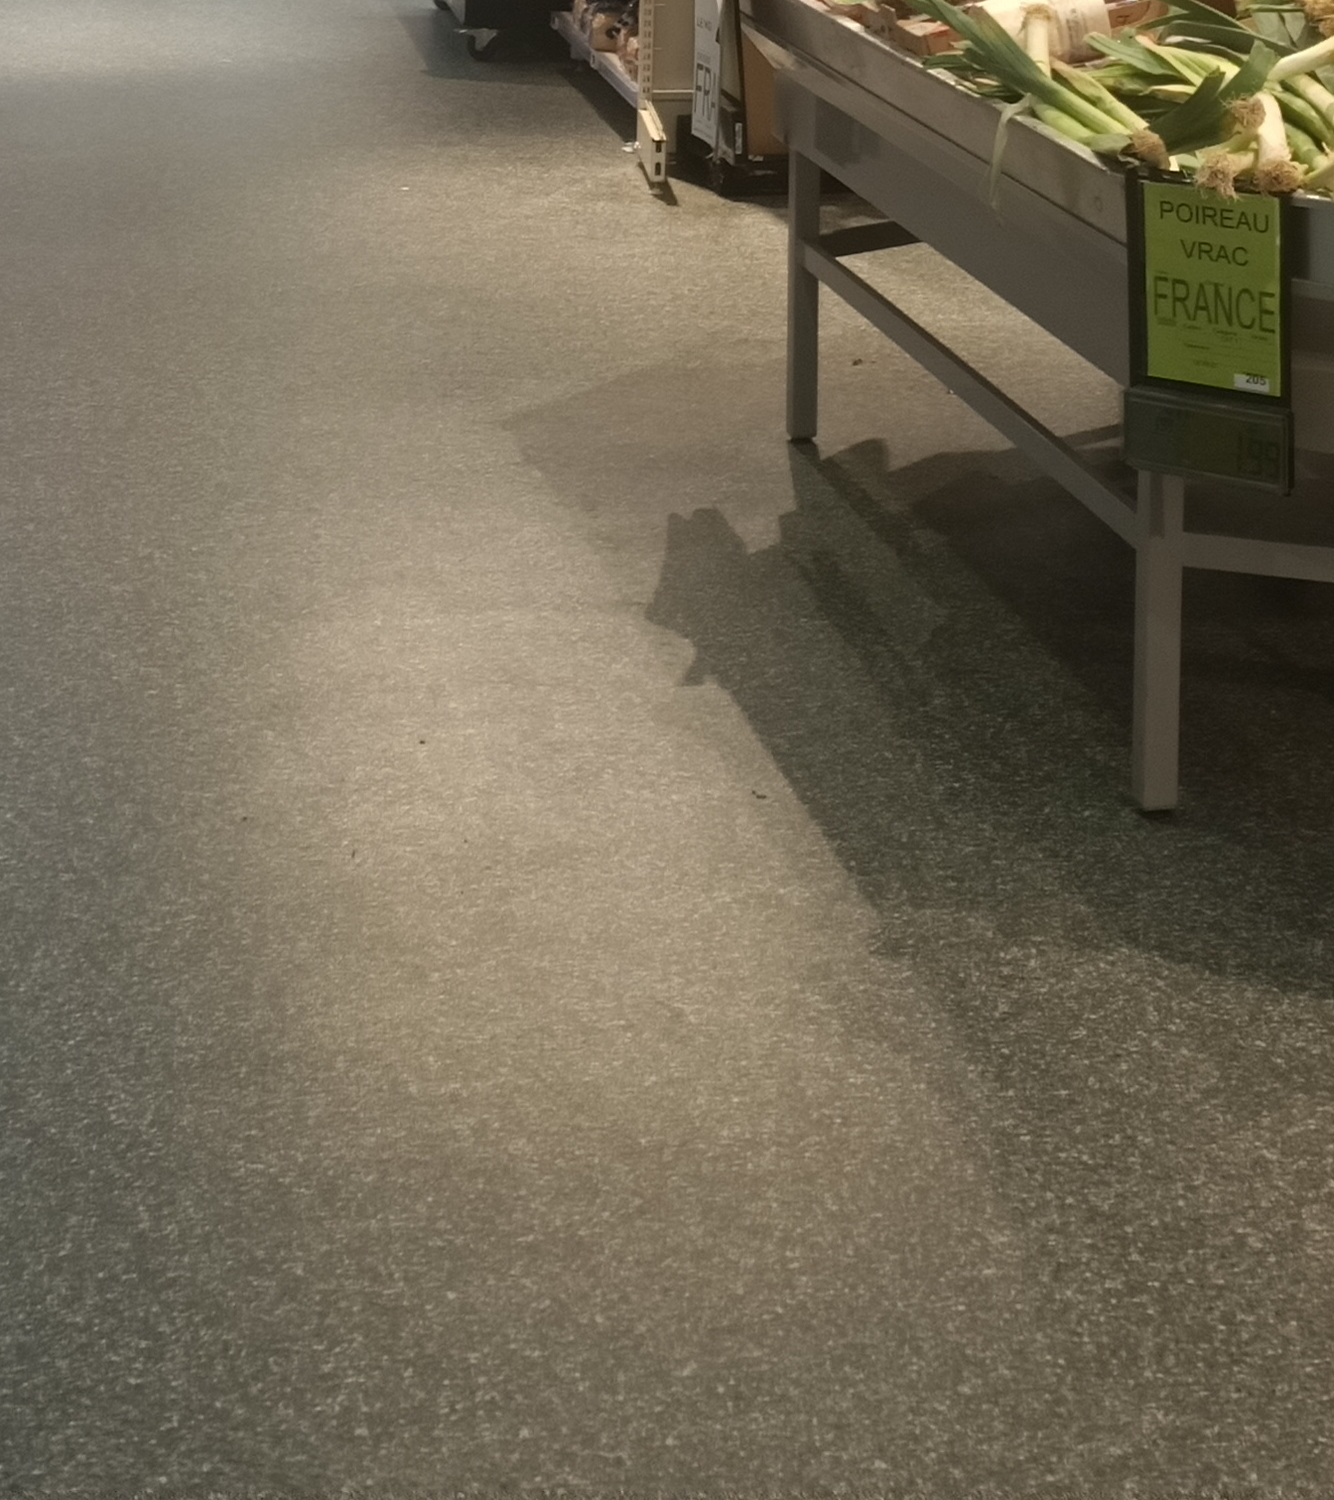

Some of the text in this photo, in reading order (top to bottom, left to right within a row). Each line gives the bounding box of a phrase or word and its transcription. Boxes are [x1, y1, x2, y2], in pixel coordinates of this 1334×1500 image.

[1159, 200, 1270, 234] POIREAU
[1180, 238, 1250, 268] VRAC
[1153, 275, 1276, 335] FRANCE
[1244, 372, 1267, 386] 205
